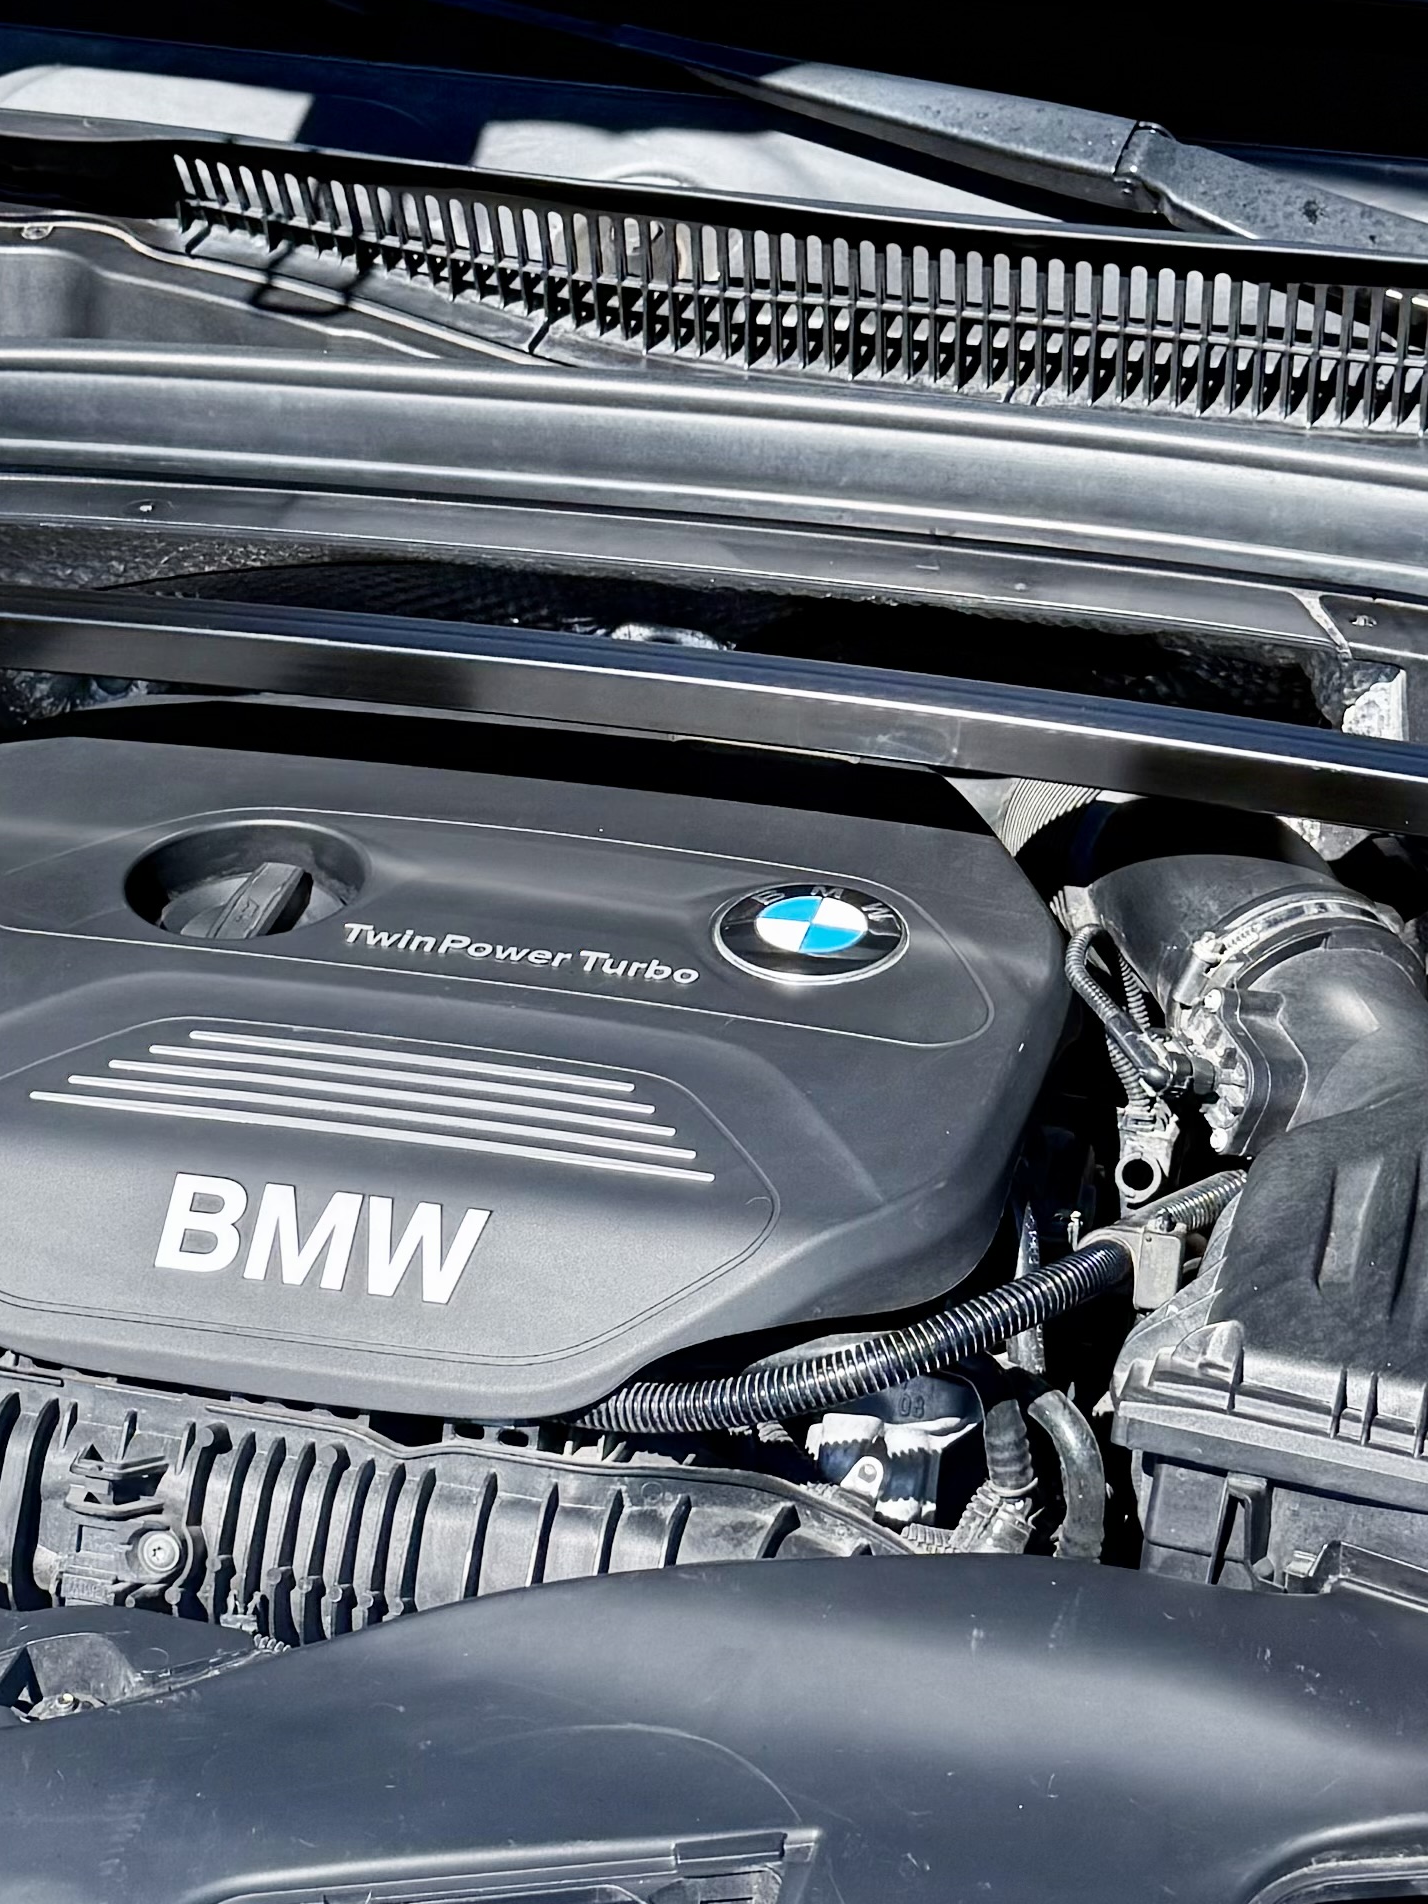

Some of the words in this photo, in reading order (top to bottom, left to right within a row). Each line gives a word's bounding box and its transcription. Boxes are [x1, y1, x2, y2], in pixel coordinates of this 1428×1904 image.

[750, 885, 893, 922] BMW
[343, 923, 572, 968] TwinPower
[580, 950, 700, 985] Turbo
[154, 1172, 493, 1304] BMW
